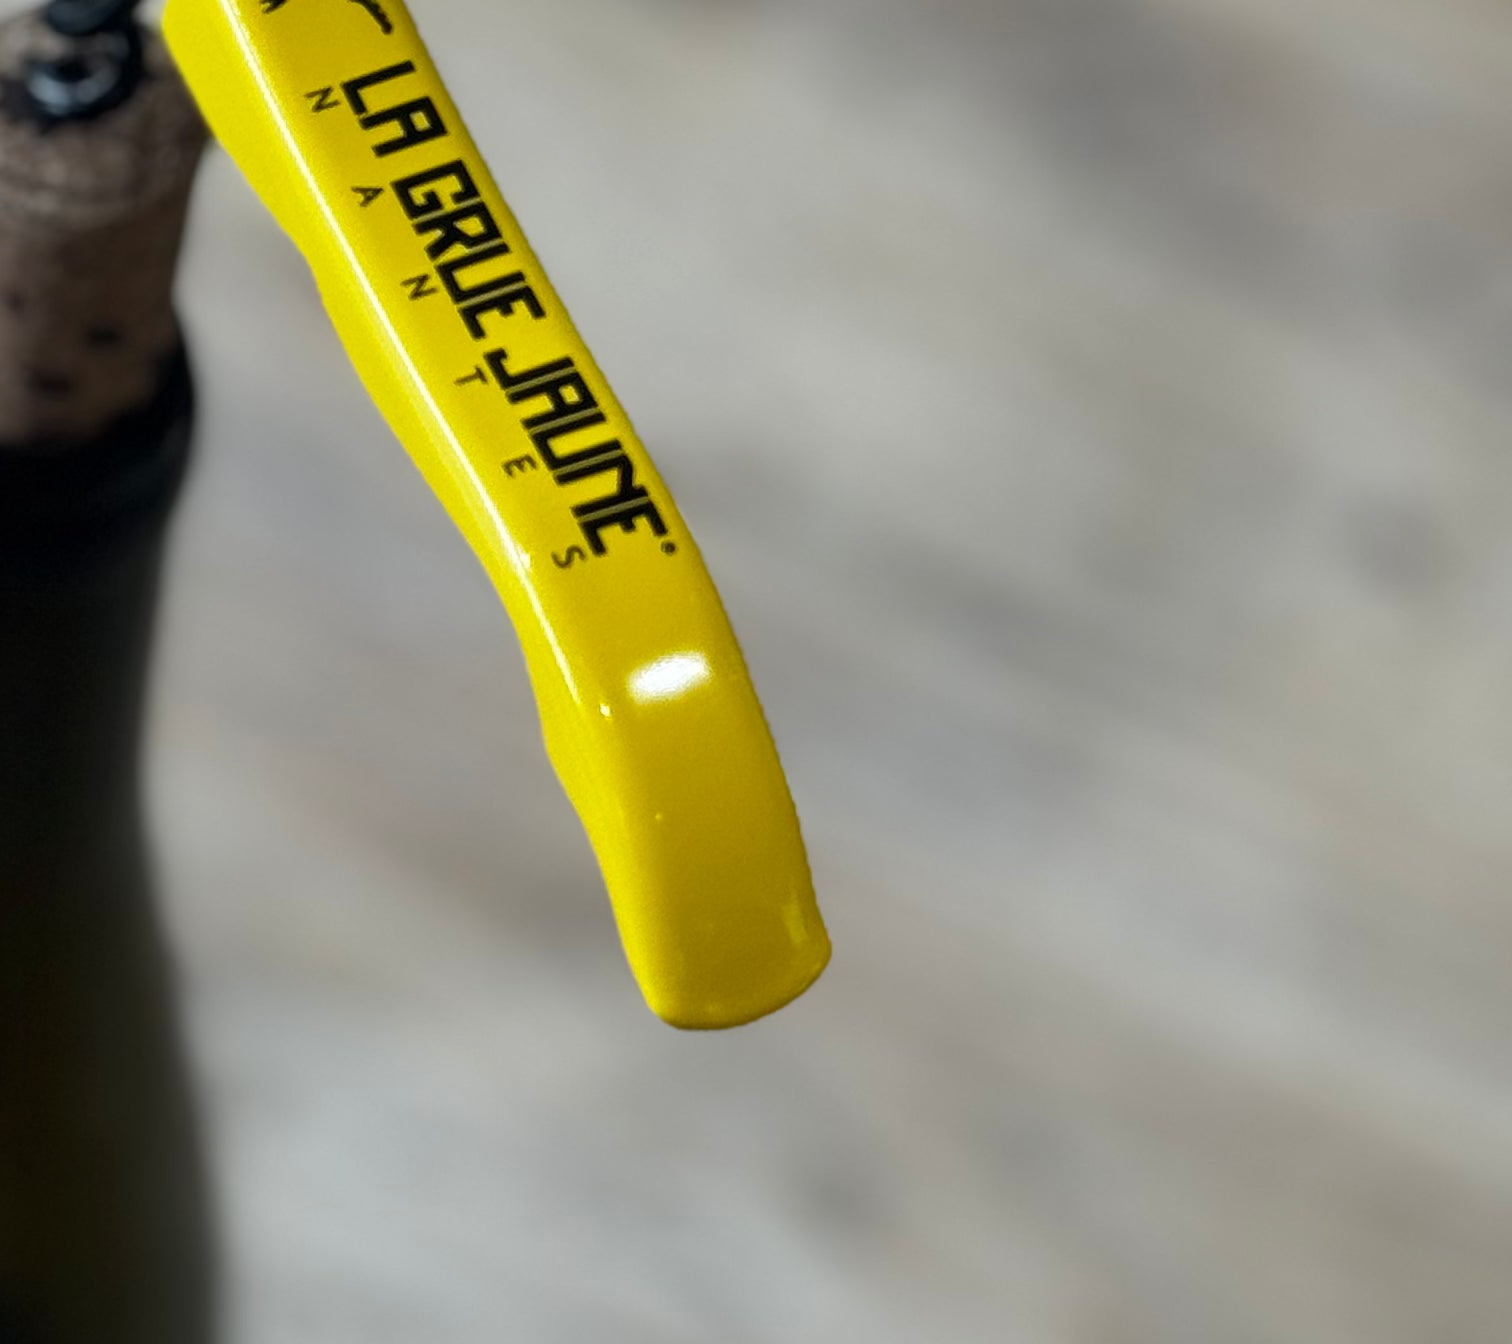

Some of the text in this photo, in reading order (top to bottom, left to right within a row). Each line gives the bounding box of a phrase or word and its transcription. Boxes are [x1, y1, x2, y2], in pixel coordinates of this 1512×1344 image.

[341, 61, 447, 156] LA
[305, 87, 585, 568] NANTES
[391, 159, 546, 340] GRUE
